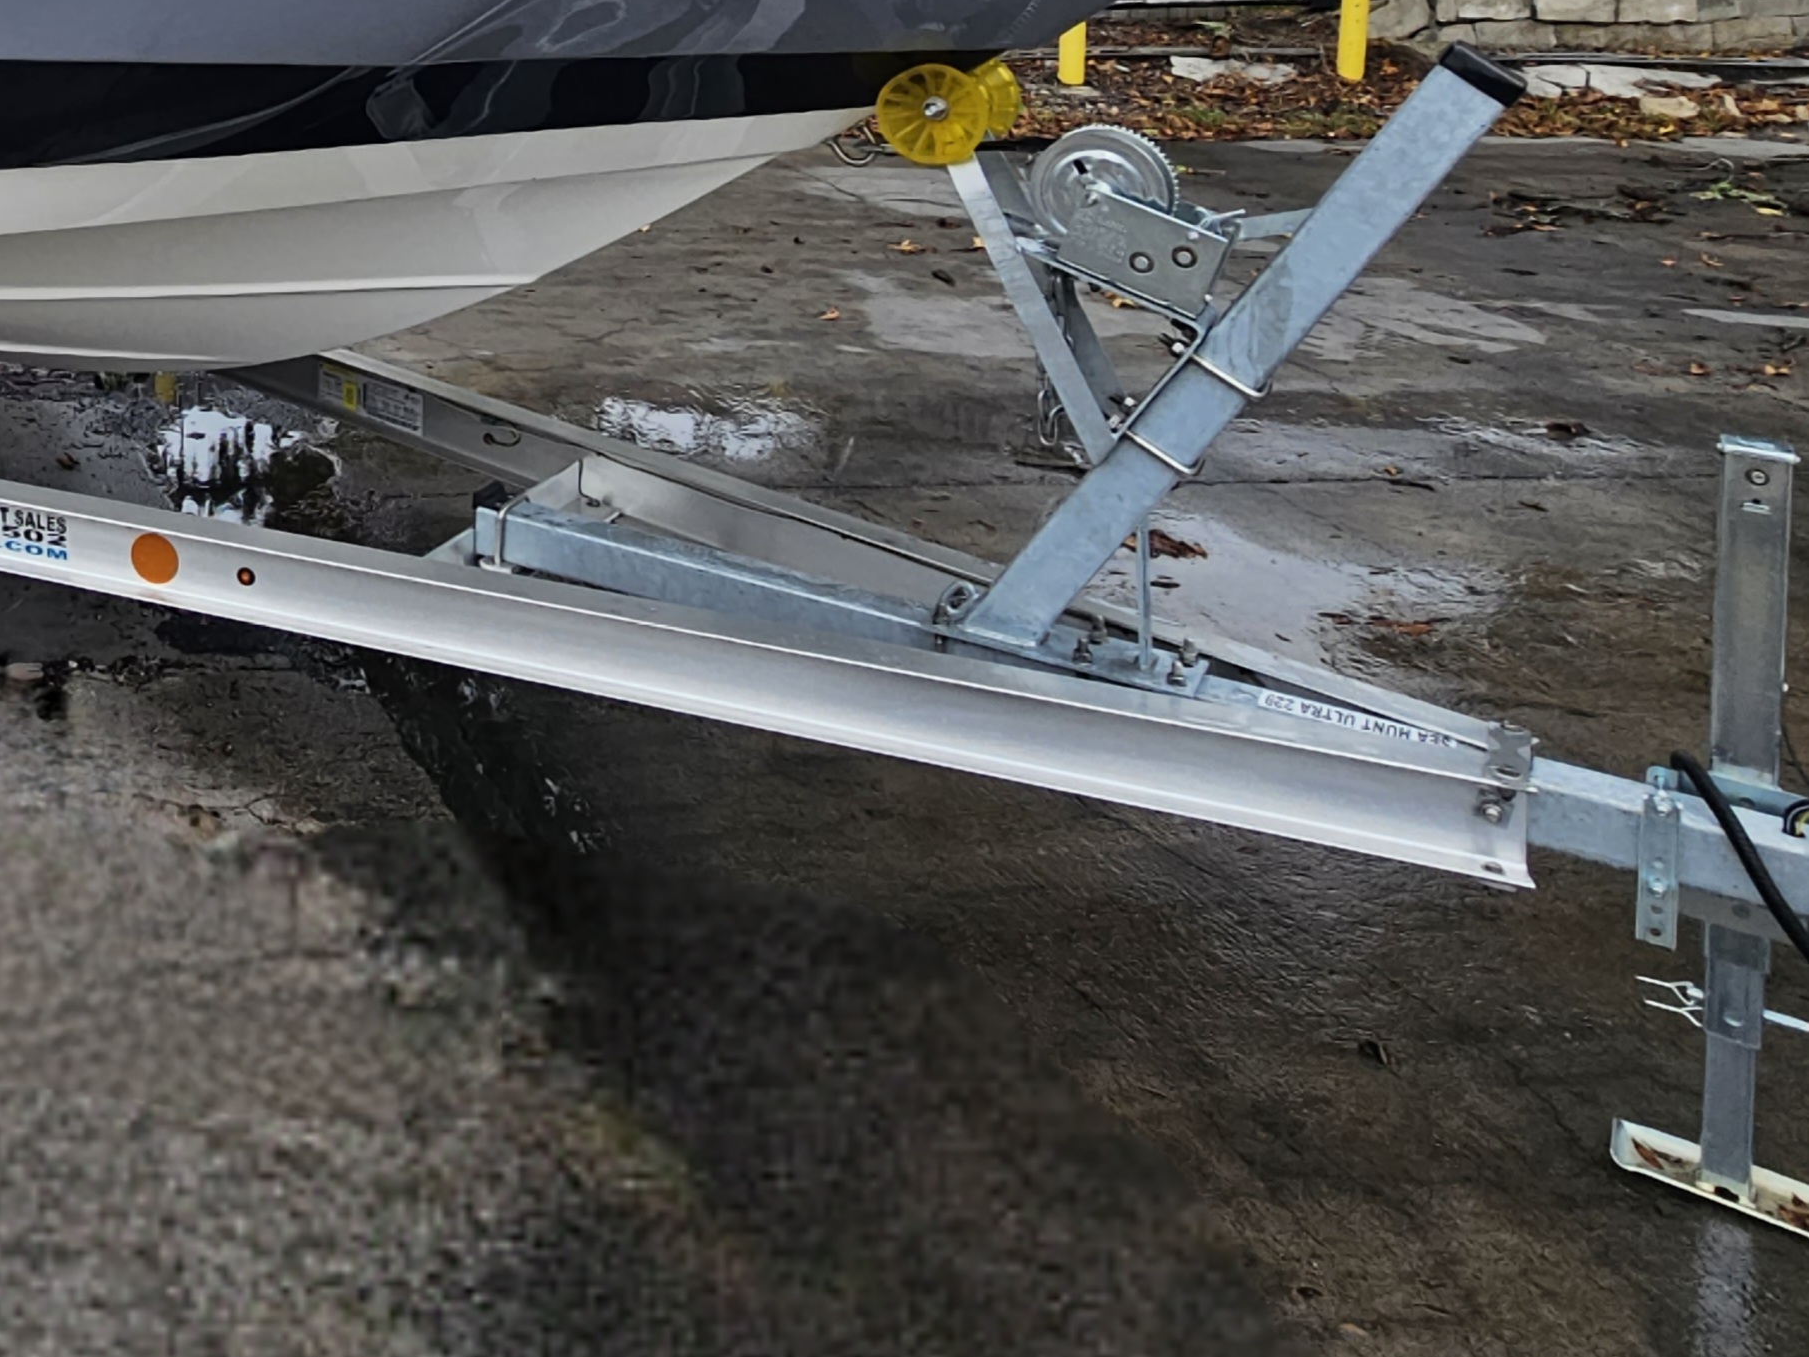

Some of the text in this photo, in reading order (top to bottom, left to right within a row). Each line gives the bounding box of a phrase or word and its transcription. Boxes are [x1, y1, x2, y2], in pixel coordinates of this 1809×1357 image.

[14, 509, 68, 535] SALES
[1300, 701, 1356, 727] ULTRA
[1361, 723, 1411, 740] HUNT
[1417, 731, 1454, 747] SEA
